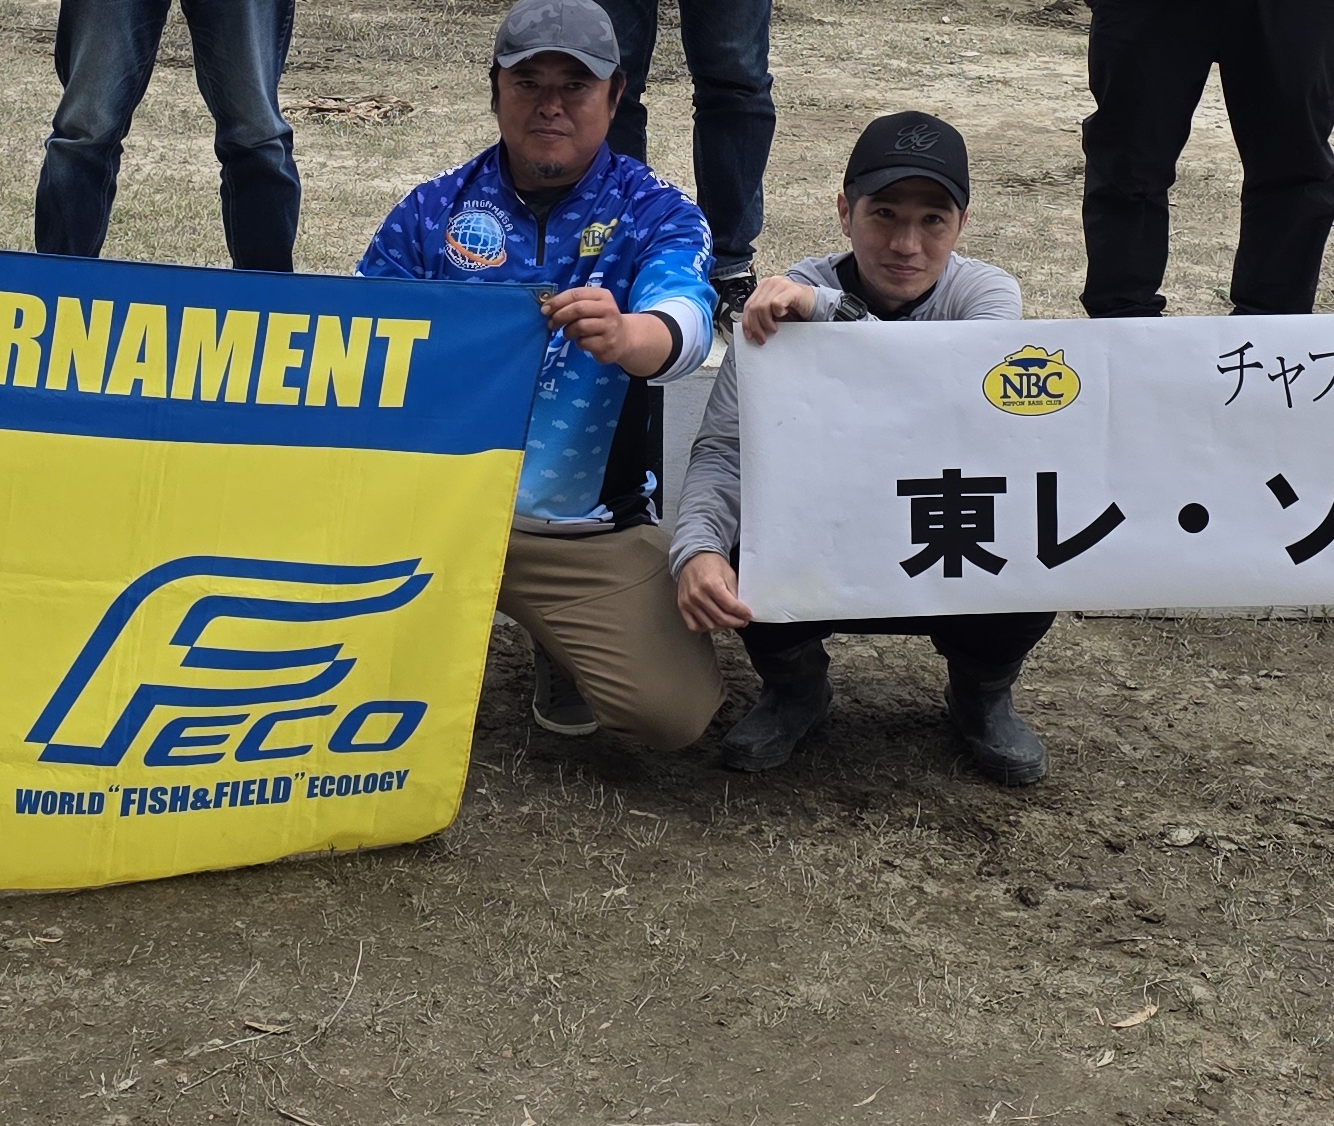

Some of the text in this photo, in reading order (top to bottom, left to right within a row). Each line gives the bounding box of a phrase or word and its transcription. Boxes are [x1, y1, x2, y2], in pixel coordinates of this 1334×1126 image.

[999, 371, 1065, 399] NBC
[14, 787, 105, 816] WORLD
[306, 769, 410, 801] ECOLOGY
